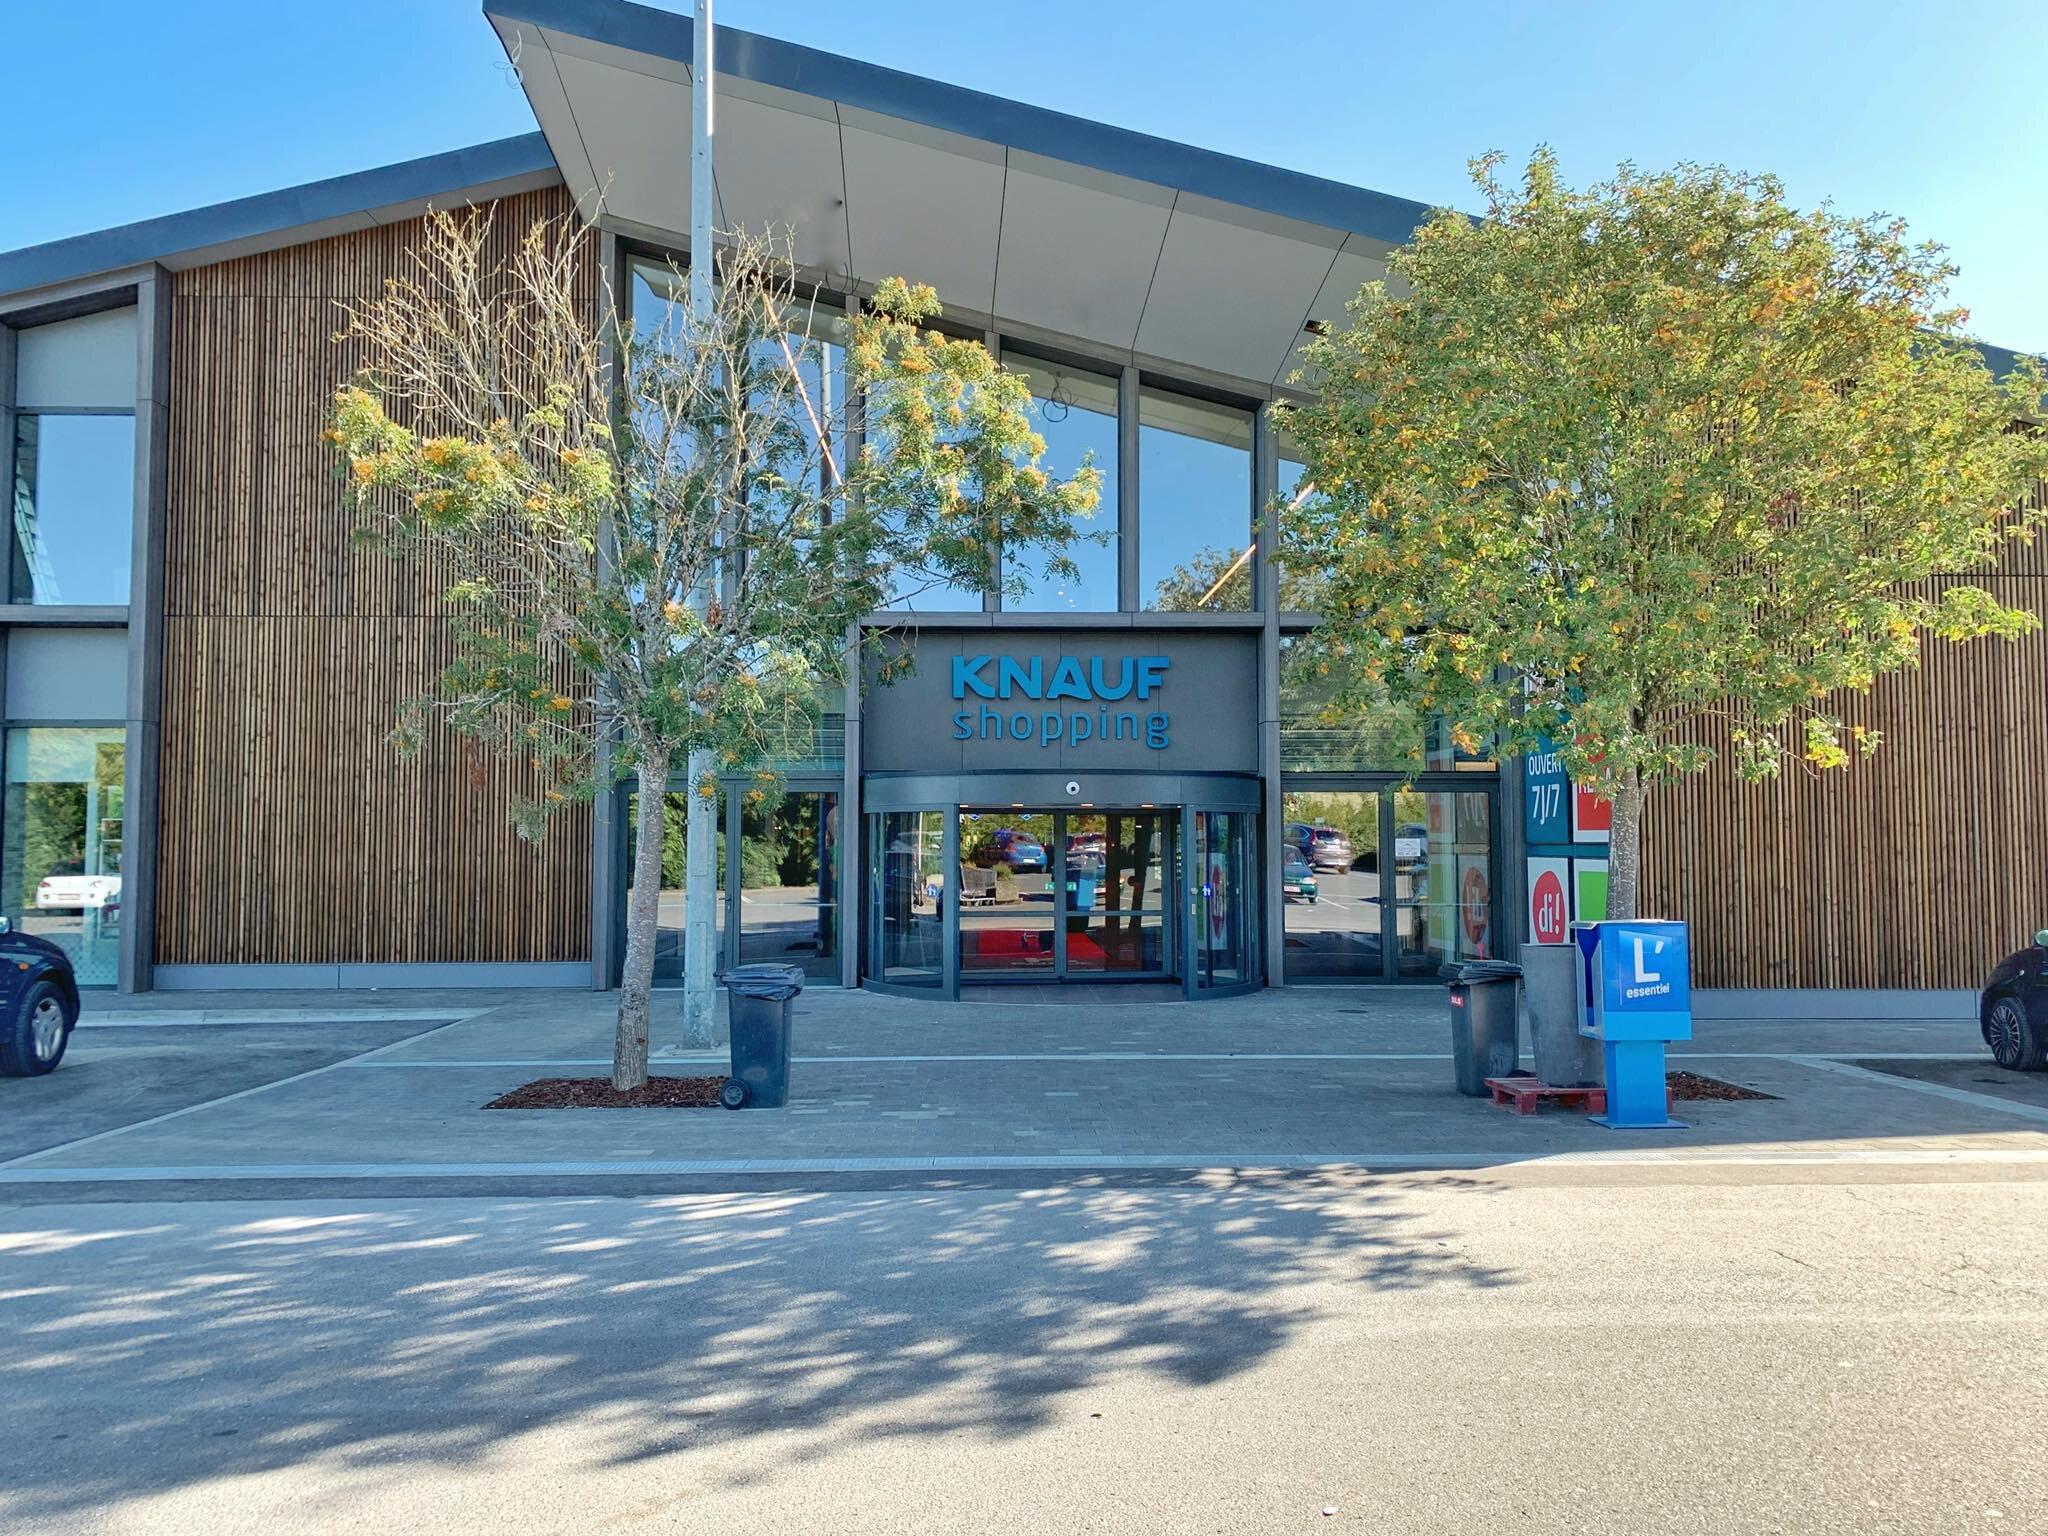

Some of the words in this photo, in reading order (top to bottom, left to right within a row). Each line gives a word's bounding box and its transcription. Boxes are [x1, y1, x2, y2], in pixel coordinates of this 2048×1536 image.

[952, 655, 1170, 700] KNAUF
[953, 704, 1169, 749] shopping
[1539, 893, 1560, 934] di!
[1634, 938, 1664, 983] L'
[1626, 982, 1670, 999] essentiel
